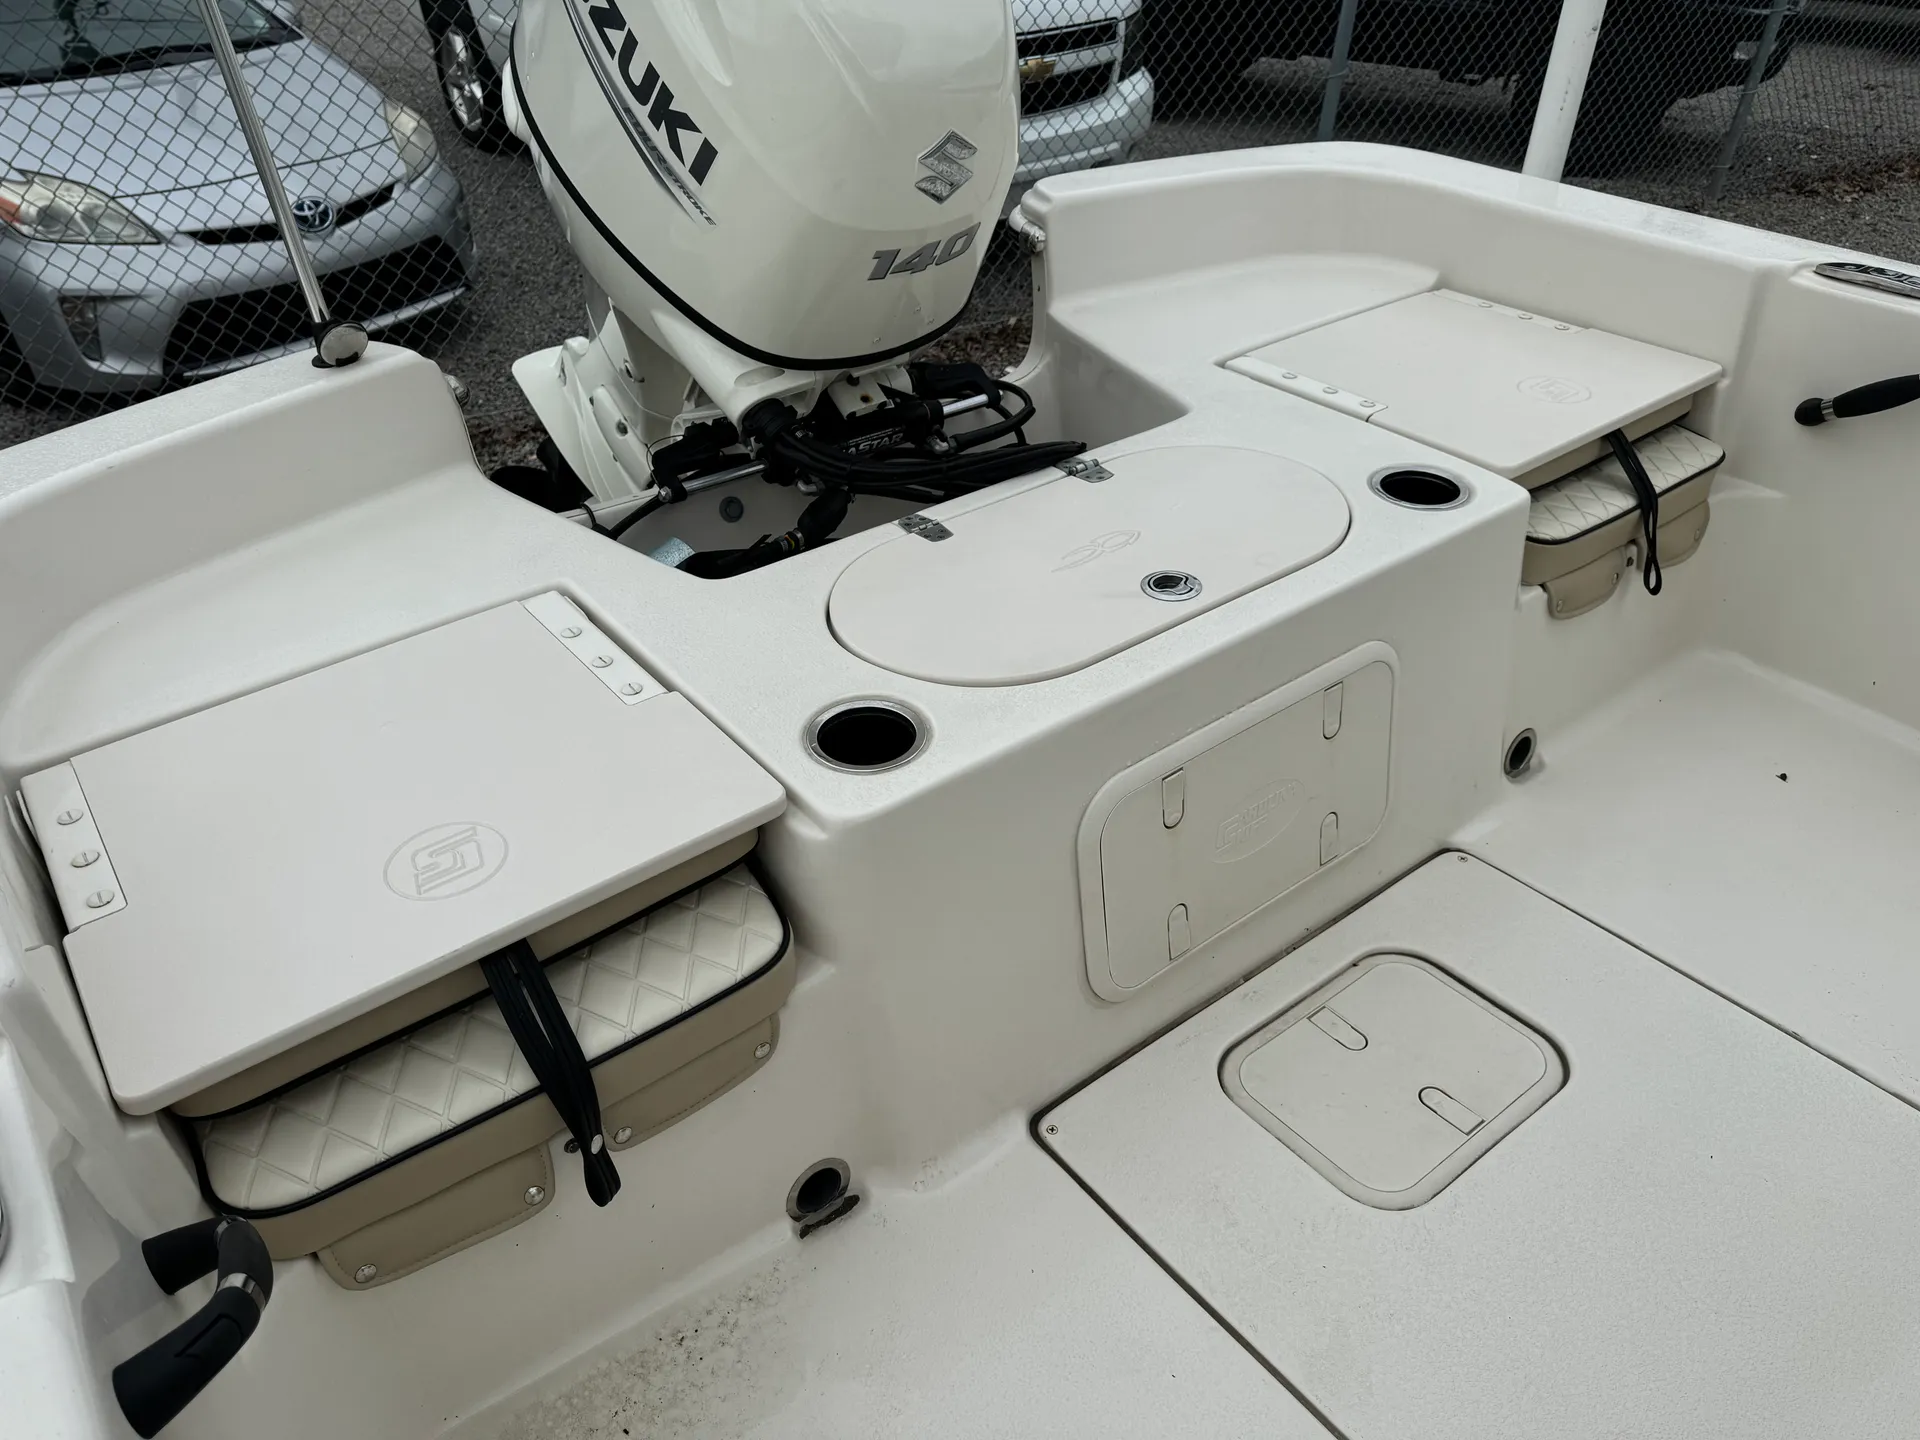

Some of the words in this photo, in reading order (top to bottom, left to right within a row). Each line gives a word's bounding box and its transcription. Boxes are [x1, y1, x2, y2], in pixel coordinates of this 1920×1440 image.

[583, 0, 718, 186] ZUKI
[868, 222, 981, 280] 140
[847, 432, 904, 456] ASTAR
